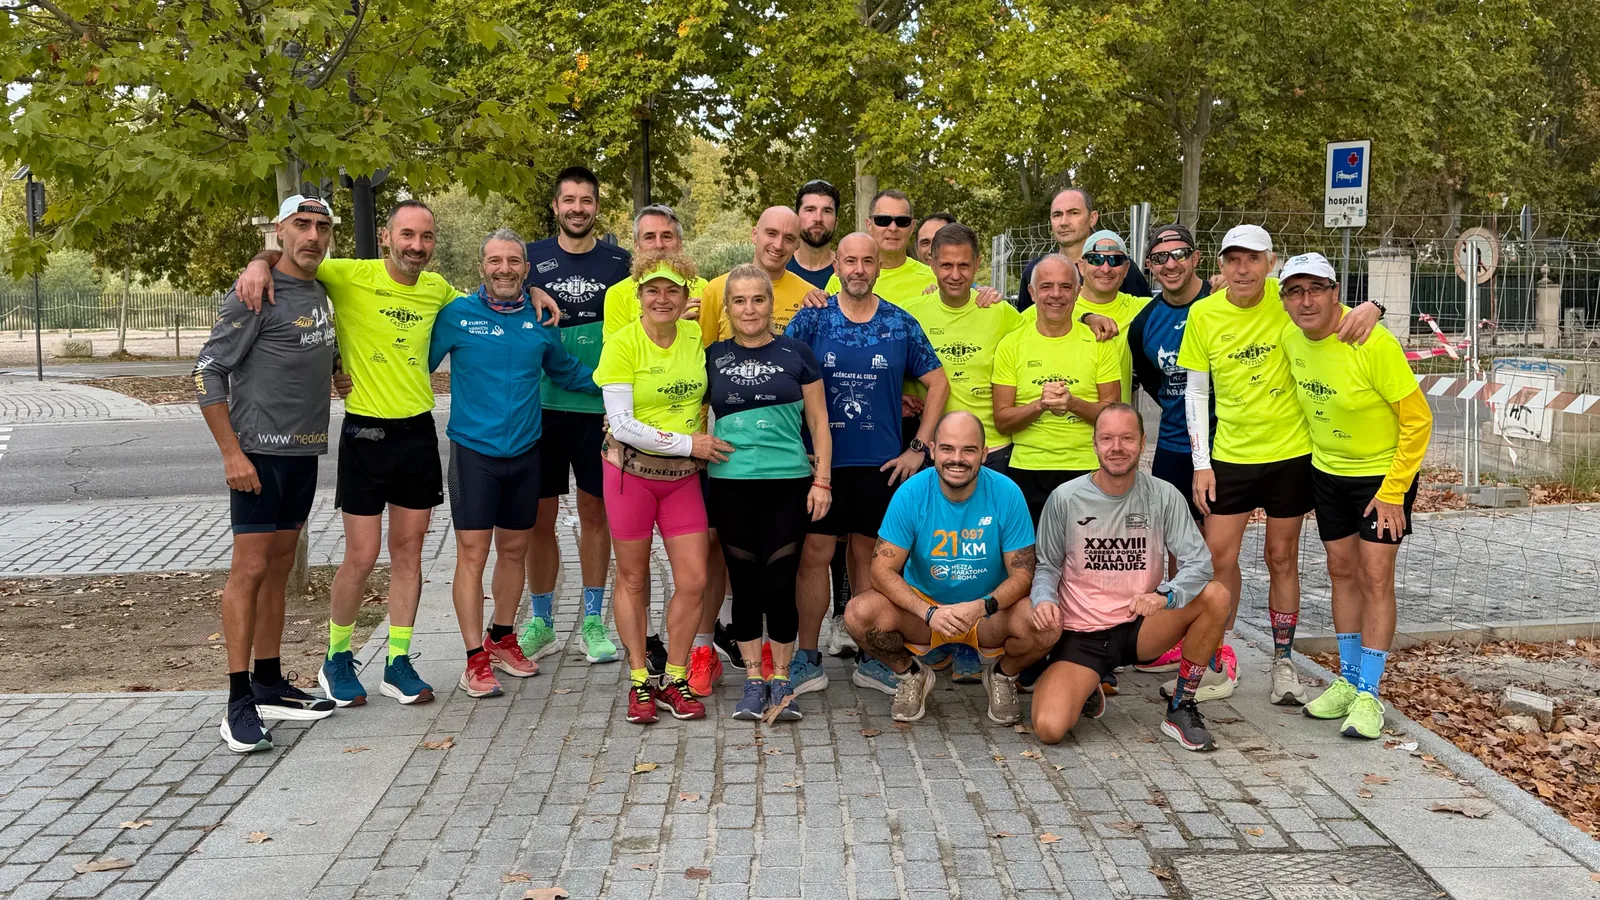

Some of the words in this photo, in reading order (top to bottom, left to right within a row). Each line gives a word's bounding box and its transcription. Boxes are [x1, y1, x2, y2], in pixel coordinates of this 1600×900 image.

[1328, 195, 1363, 206] hospital
[558, 291, 595, 303] CASTILLA
[389, 318, 417, 329] CASTILLA
[944, 354, 974, 363] CASTILLA
[1239, 354, 1269, 366] CASTILLA
[730, 374, 772, 386] CASTILLA
[832, 371, 856, 379] ACÉRCATE
[1305, 390, 1331, 402] CASTILLA
[930, 529, 958, 557] 21
[961, 528, 984, 540] 097
[1084, 537, 1146, 549] XXXVIII
[962, 542, 987, 556] KM
[951, 567, 988, 576] MARATONA
[1084, 562, 1146, 571] ARANJUEZ
